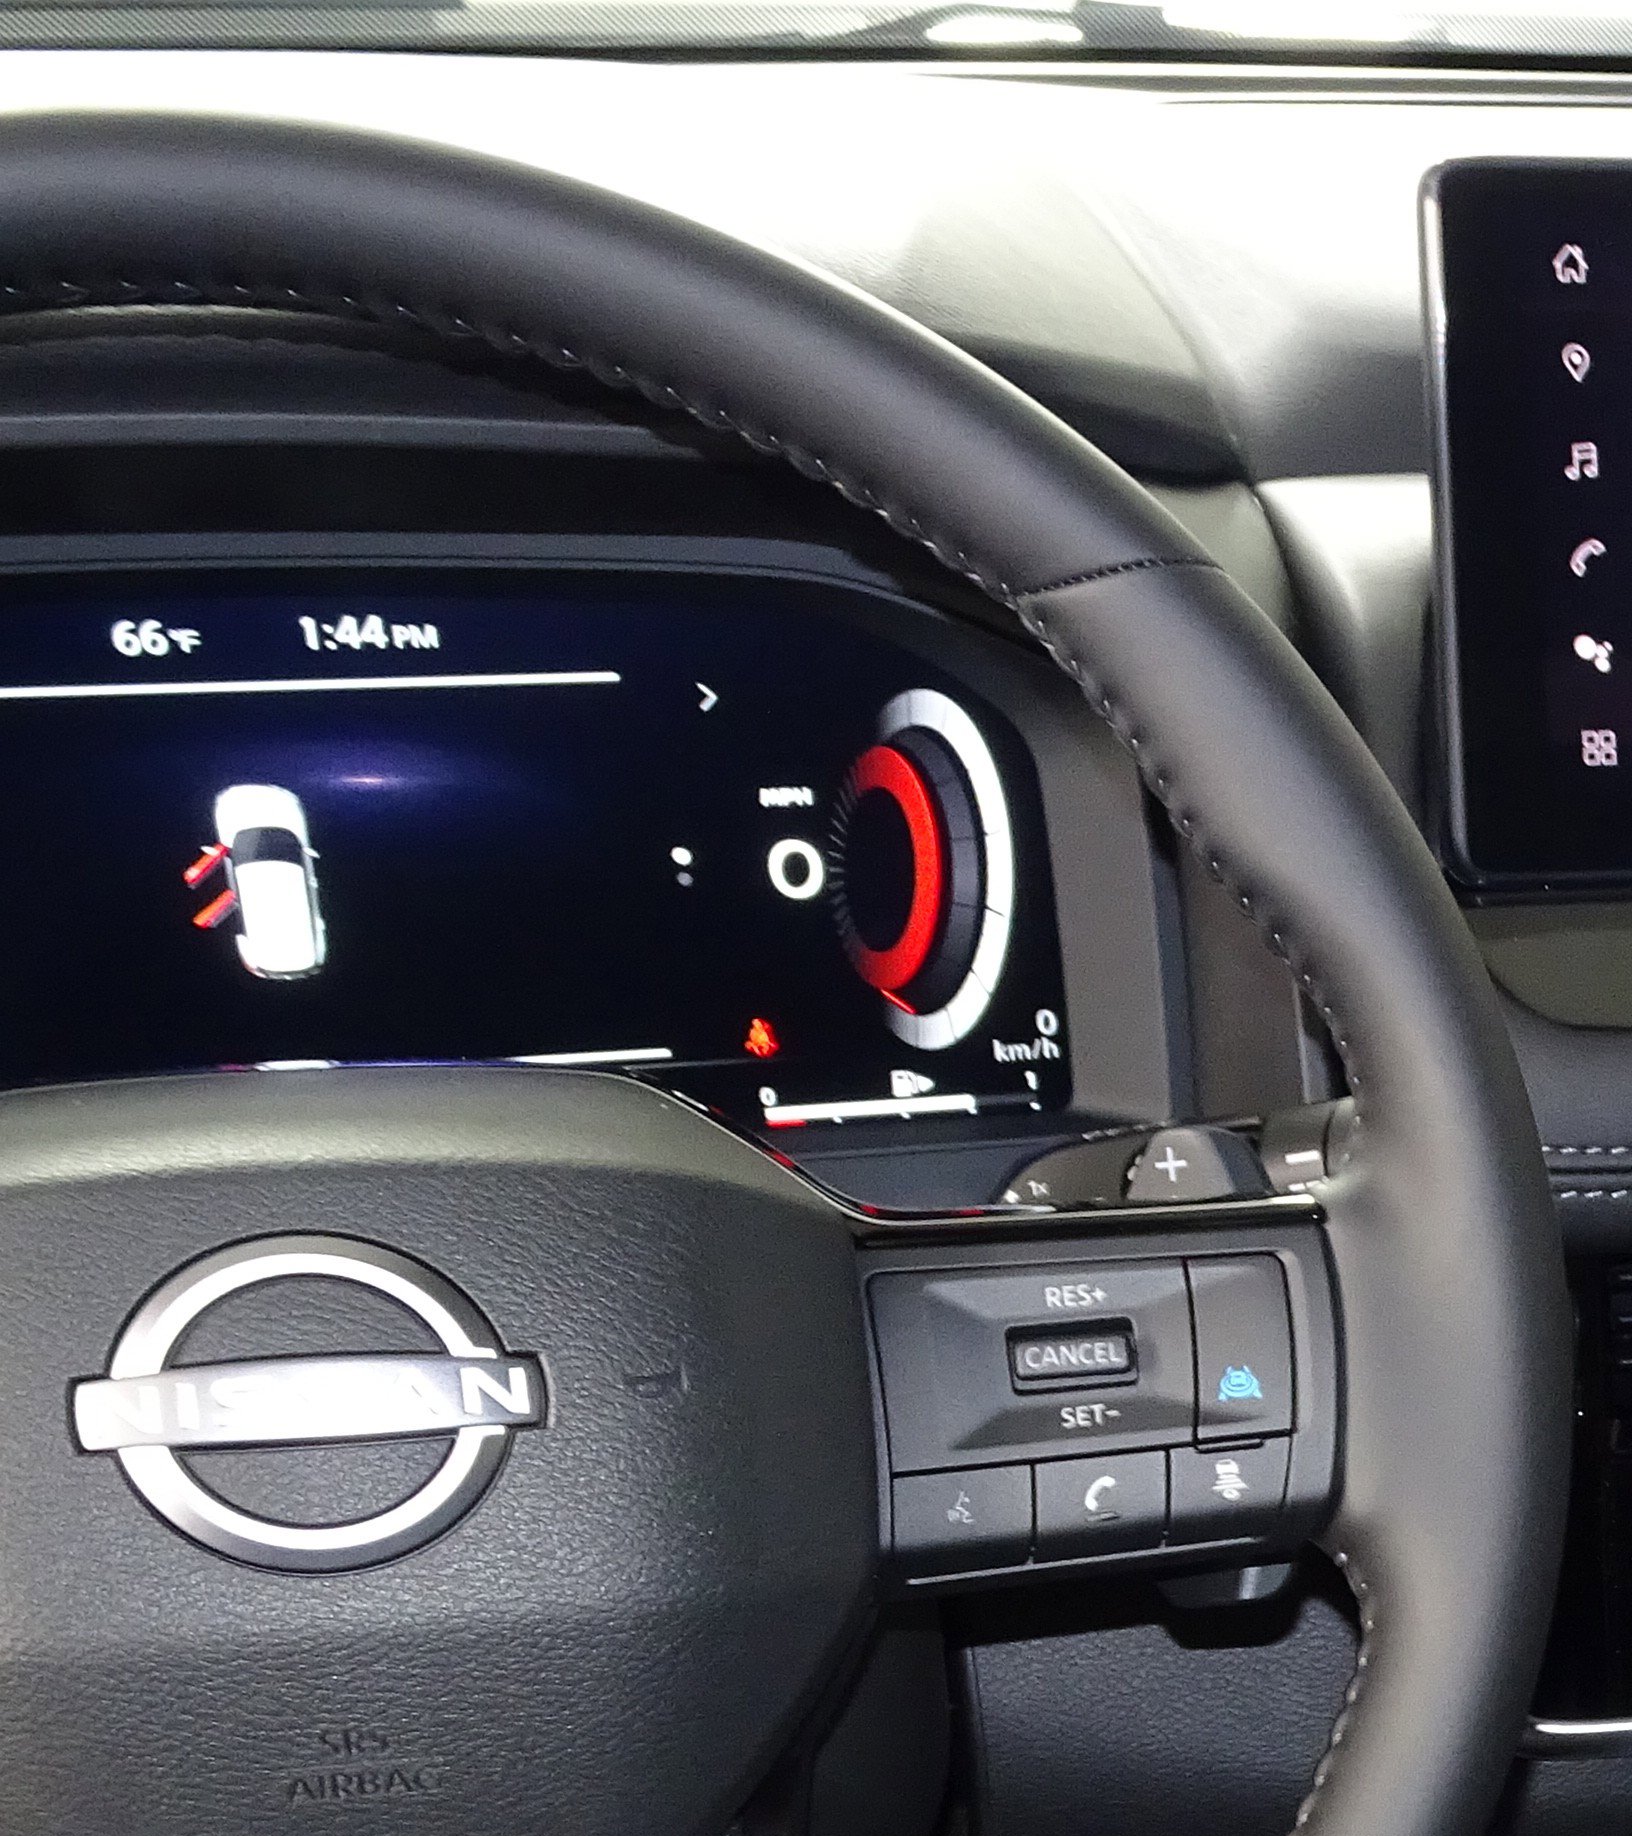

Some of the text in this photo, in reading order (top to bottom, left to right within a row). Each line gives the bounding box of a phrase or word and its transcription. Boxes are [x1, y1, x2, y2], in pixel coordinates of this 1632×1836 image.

[766, 837, 824, 900] 0
[1034, 1008, 1059, 1036] 0
[992, 1037, 1061, 1063] km/h
[1044, 1283, 1107, 1309] RES+
[1023, 1340, 1126, 1371] CANCEL
[1059, 1402, 1122, 1430] SET-
